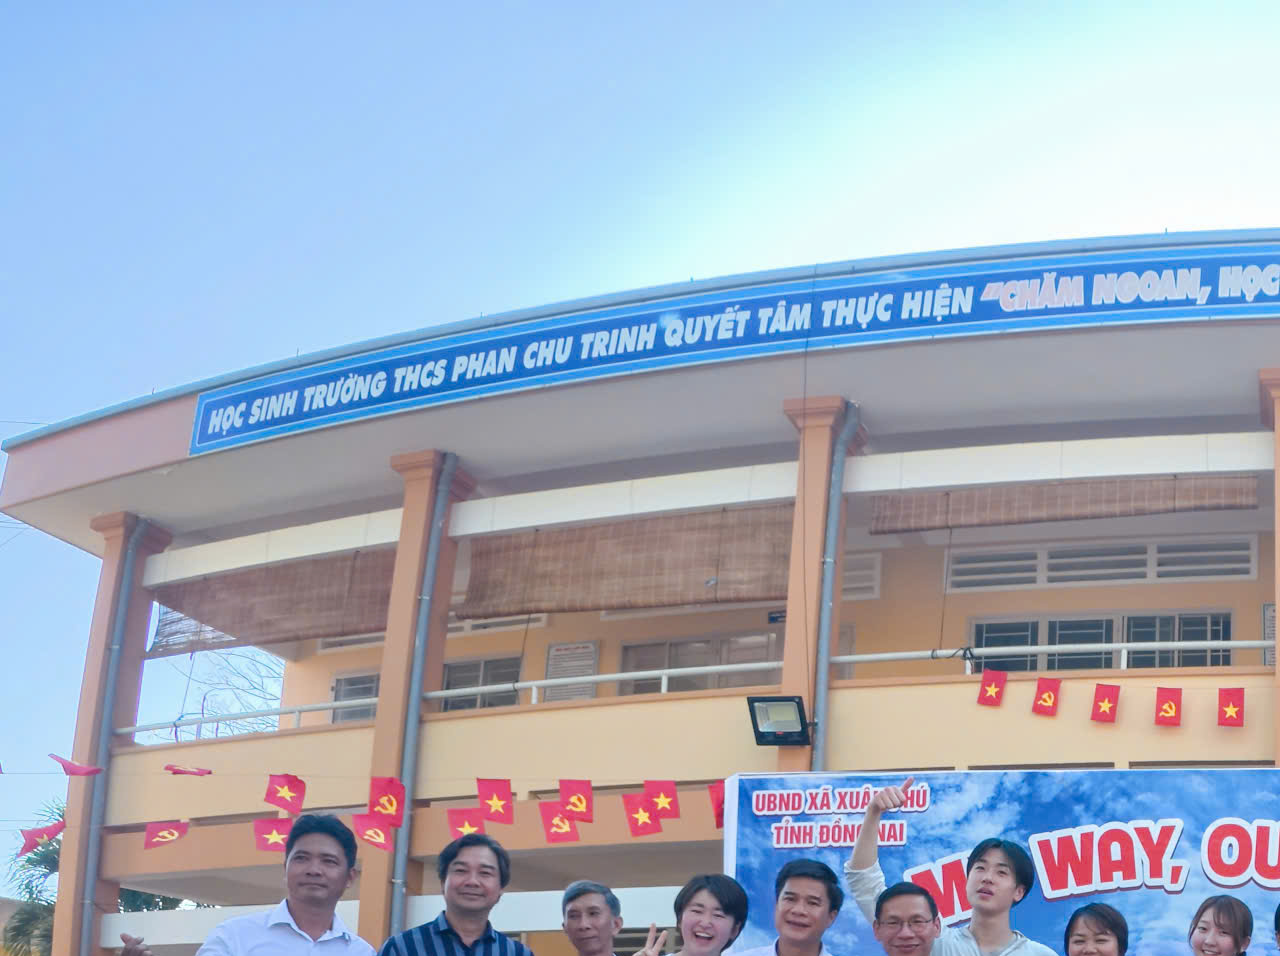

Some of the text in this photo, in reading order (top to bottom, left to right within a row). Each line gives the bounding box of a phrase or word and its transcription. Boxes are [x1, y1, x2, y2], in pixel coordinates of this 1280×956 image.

[208, 402, 247, 435] HỌC
[248, 390, 298, 425] SINH
[303, 371, 387, 412] TRƯỜNG
[393, 358, 448, 393] THCS
[451, 346, 518, 382] PHAN
[523, 336, 573, 369] CHU
[580, 323, 657, 360] TRINH
[664, 305, 751, 347] QUYẾT
[758, 300, 812, 335] TÂM
[822, 291, 894, 329] THỰC
[901, 282, 974, 322] HIỆN
[1218, 264, 1280, 302] HỌC
[755, 792, 803, 812] UBND
[808, 787, 831, 811] XÃ
[774, 819, 813, 844] TỈNH
[1037, 825, 1184, 891] WAY,
